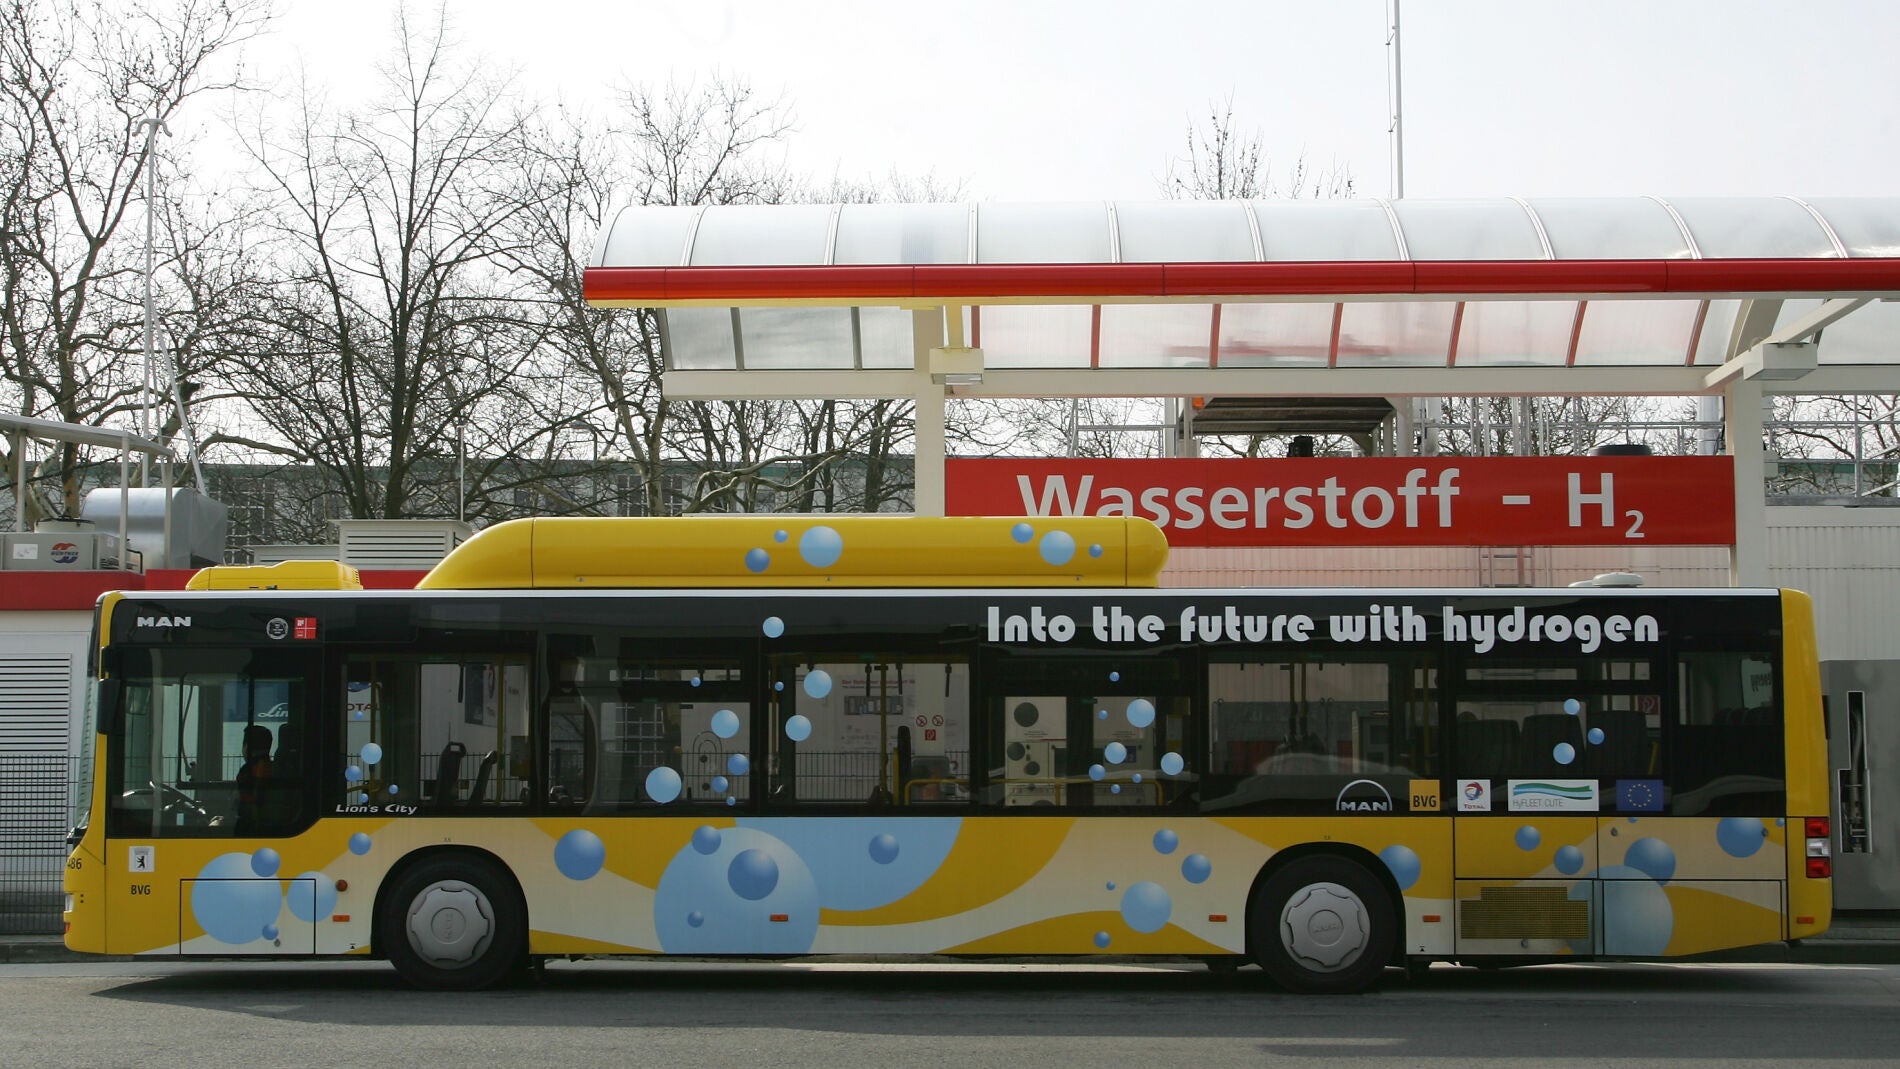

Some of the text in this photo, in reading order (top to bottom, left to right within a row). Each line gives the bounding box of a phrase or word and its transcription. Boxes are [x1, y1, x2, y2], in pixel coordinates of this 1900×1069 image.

[1016, 467, 1645, 538] Wasserstoff - H2
[137, 616, 192, 627] MAN
[988, 604, 1659, 654] Into the future with hydrogen
[257, 702, 289, 718] Lin
[1340, 801, 1388, 811] MAN
[1412, 794, 1437, 808] BVG
[335, 803, 418, 815] Lion's City
[130, 884, 151, 895] BVG
